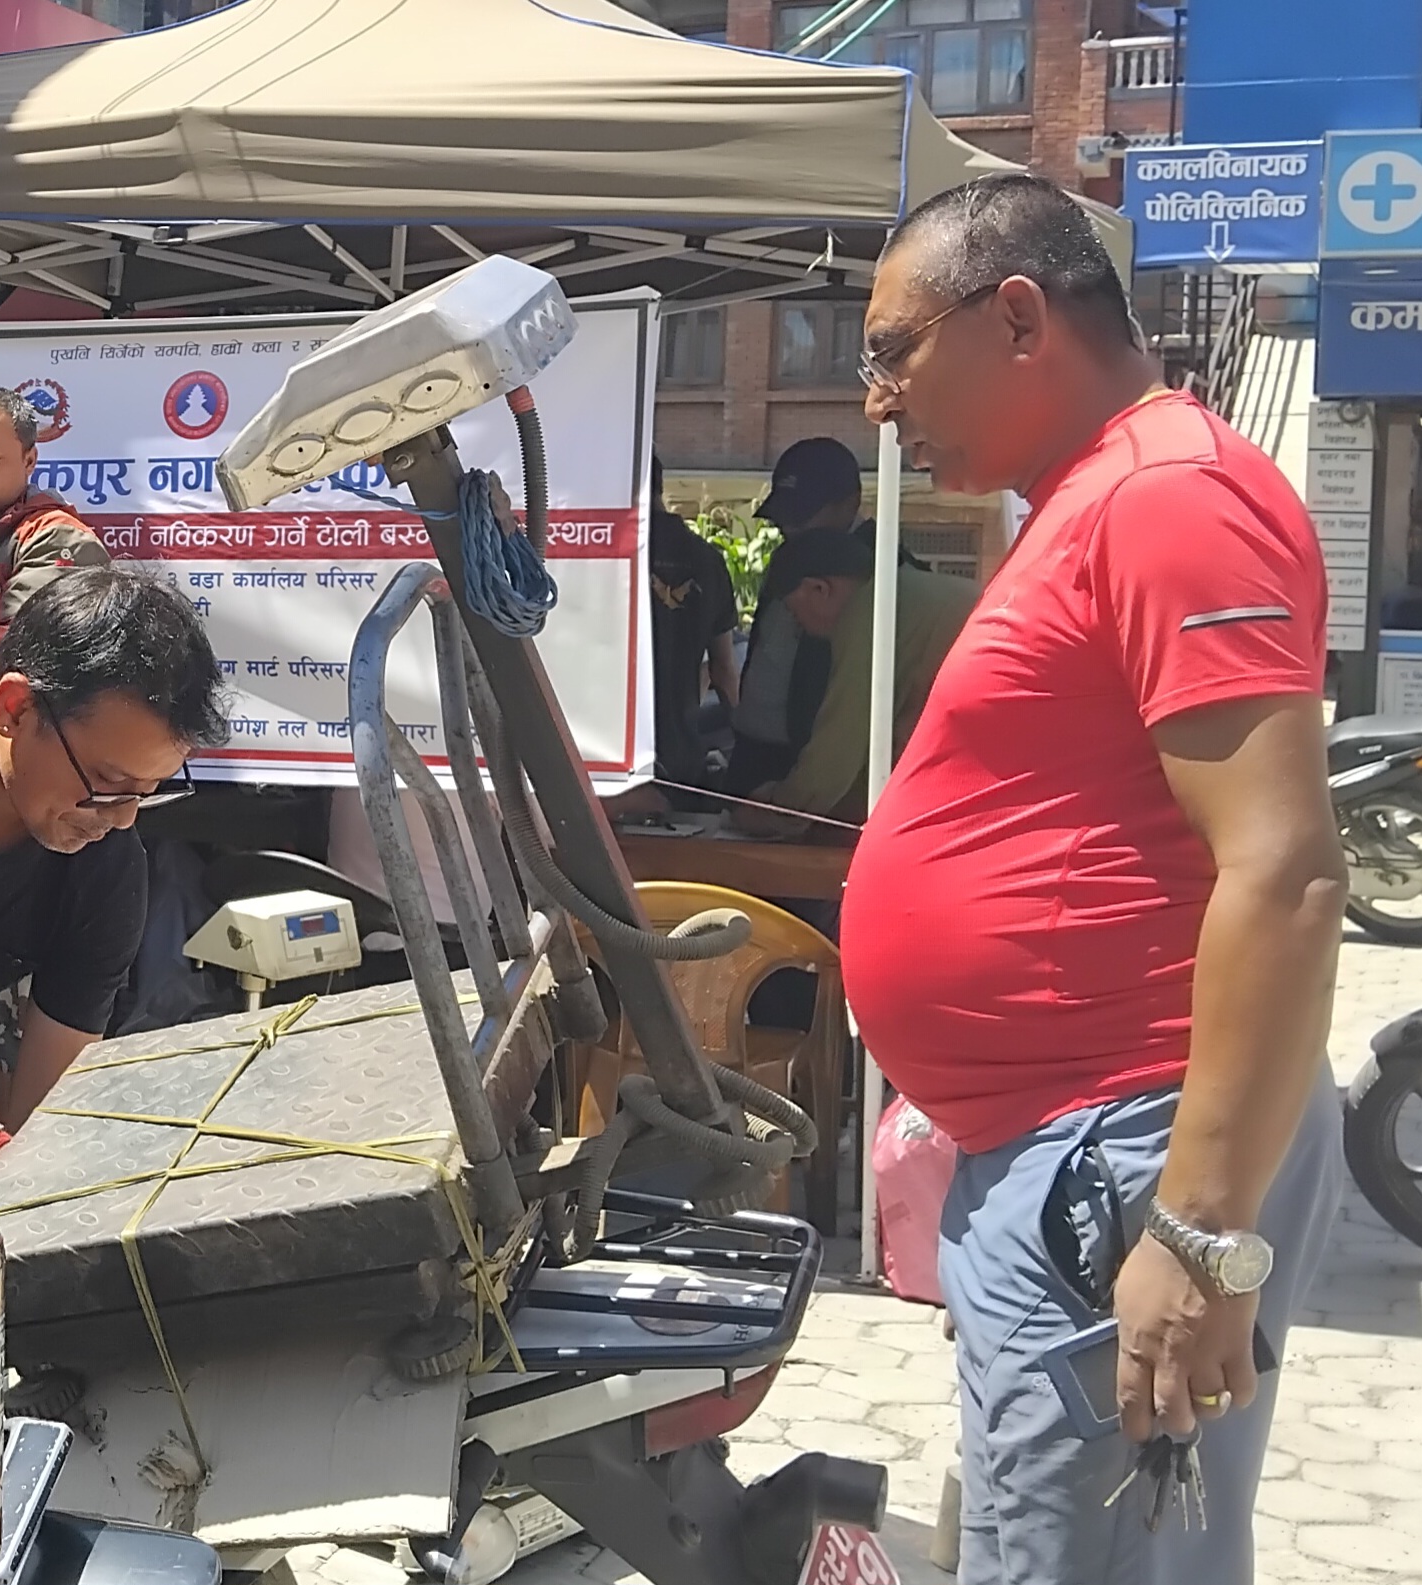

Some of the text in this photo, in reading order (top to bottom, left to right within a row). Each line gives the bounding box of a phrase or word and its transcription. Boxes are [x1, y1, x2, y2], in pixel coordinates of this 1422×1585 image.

[1137, 150, 1309, 181] कमलविनायक
[1144, 189, 1308, 222] पोलिक्लिनिक
[251, 341, 281, 354] कला
[292, 340, 300, 352] र
[103, 517, 144, 549] दर्ता
[149, 520, 255, 548] नविकरण
[264, 516, 307, 547] गर्ने
[316, 516, 373, 548] टोली
[189, 571, 224, 589] वडा
[232, 567, 308, 590] कार्यालय
[316, 566, 378, 592] परिसर
[245, 656, 280, 677] मार्ट
[288, 655, 349, 682] परिसर
[277, 720, 308, 740] तल
